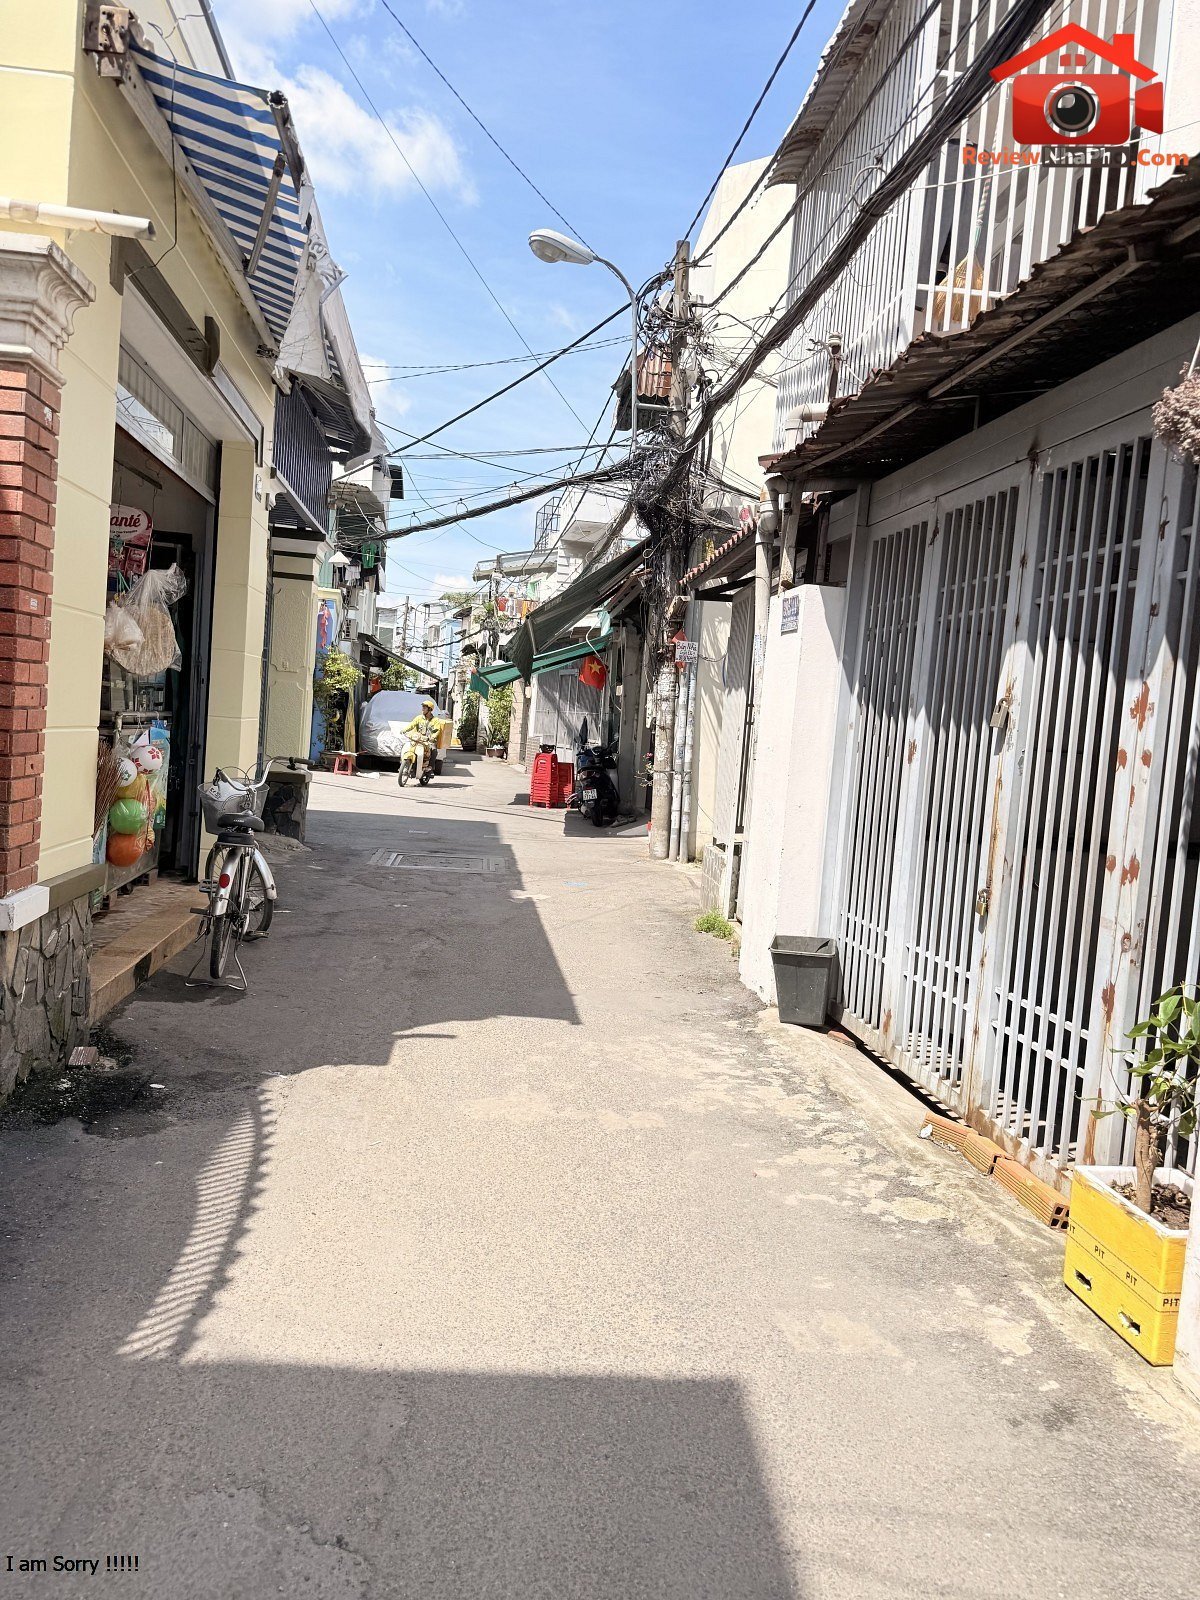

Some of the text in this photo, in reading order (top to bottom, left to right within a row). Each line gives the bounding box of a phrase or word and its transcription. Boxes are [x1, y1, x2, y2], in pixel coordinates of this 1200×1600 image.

[110, 514, 141, 527] anté
[1067, 1221, 1076, 1235] IT
[1094, 1244, 1105, 1260] PIT
[1125, 1271, 1138, 1287] PIT
[1162, 1298, 1180, 1308] PIT
